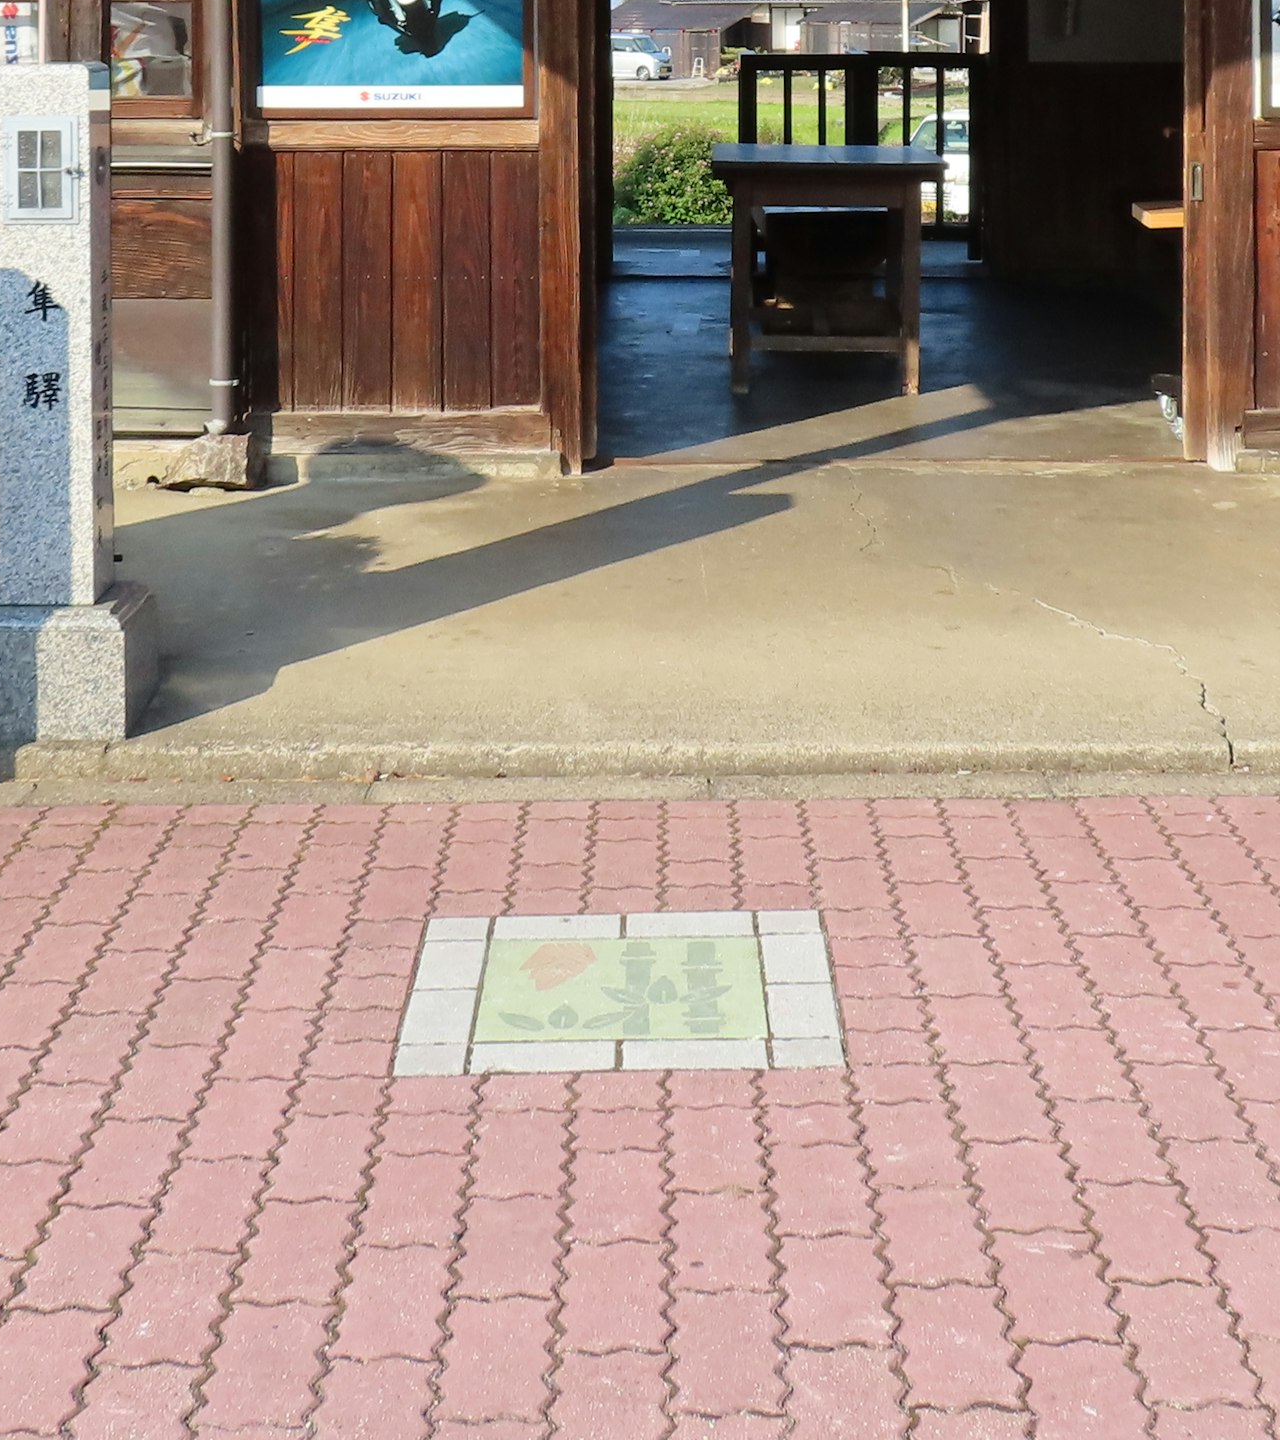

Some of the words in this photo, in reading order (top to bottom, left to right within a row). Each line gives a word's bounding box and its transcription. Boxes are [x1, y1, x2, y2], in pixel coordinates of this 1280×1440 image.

[278, 5, 353, 56] 隼
[373, 92, 422, 101] SUZUKI
[23, 280, 62, 411] 隼驛
